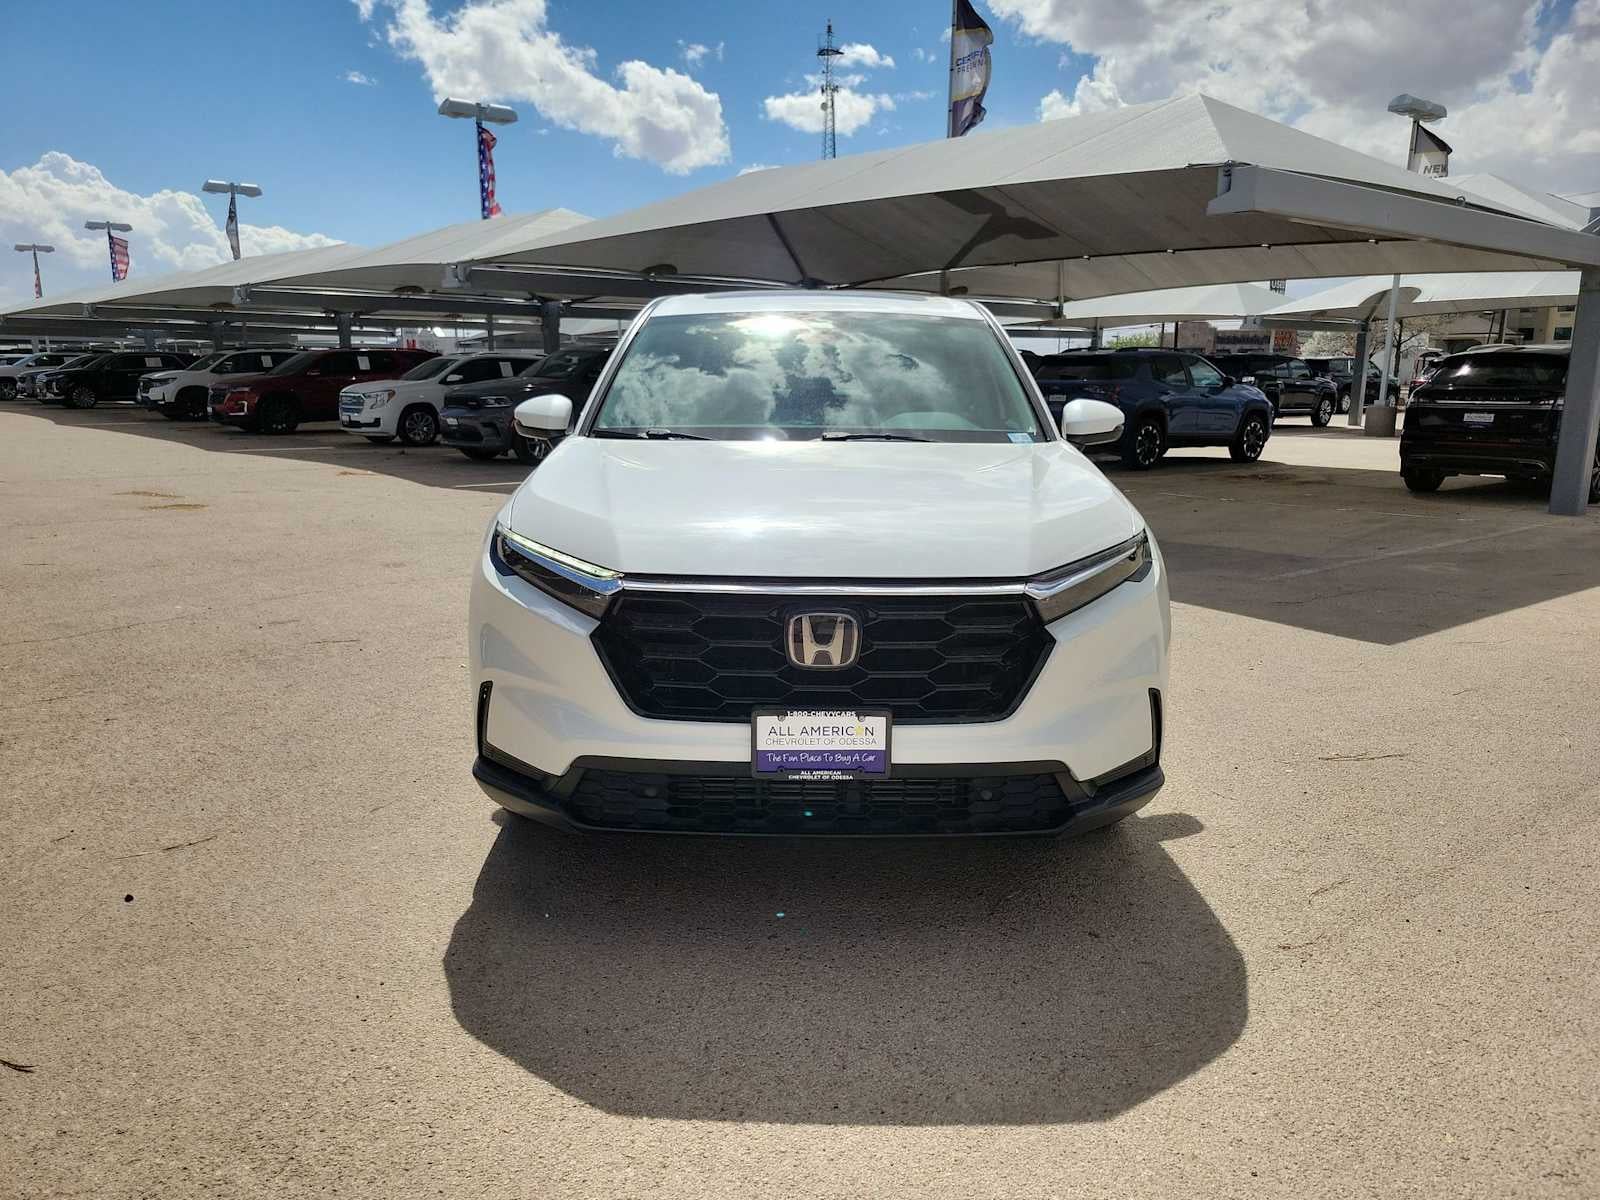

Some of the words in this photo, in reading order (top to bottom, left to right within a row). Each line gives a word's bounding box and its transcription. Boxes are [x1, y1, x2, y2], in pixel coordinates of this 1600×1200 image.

[768, 726, 795, 737] ALL
[800, 725, 874, 737] AMERICN
[766, 737, 820, 746] CHEVROLET
[823, 737, 836, 746] OF
[838, 737, 877, 746] ODESSA
[766, 752, 782, 763] The
[783, 752, 798, 762] Fun
[799, 752, 822, 763] Place
[823, 752, 834, 763] To
[835, 752, 852, 765] Buy
[852, 752, 861, 762] A
[861, 752, 876, 762] Car
